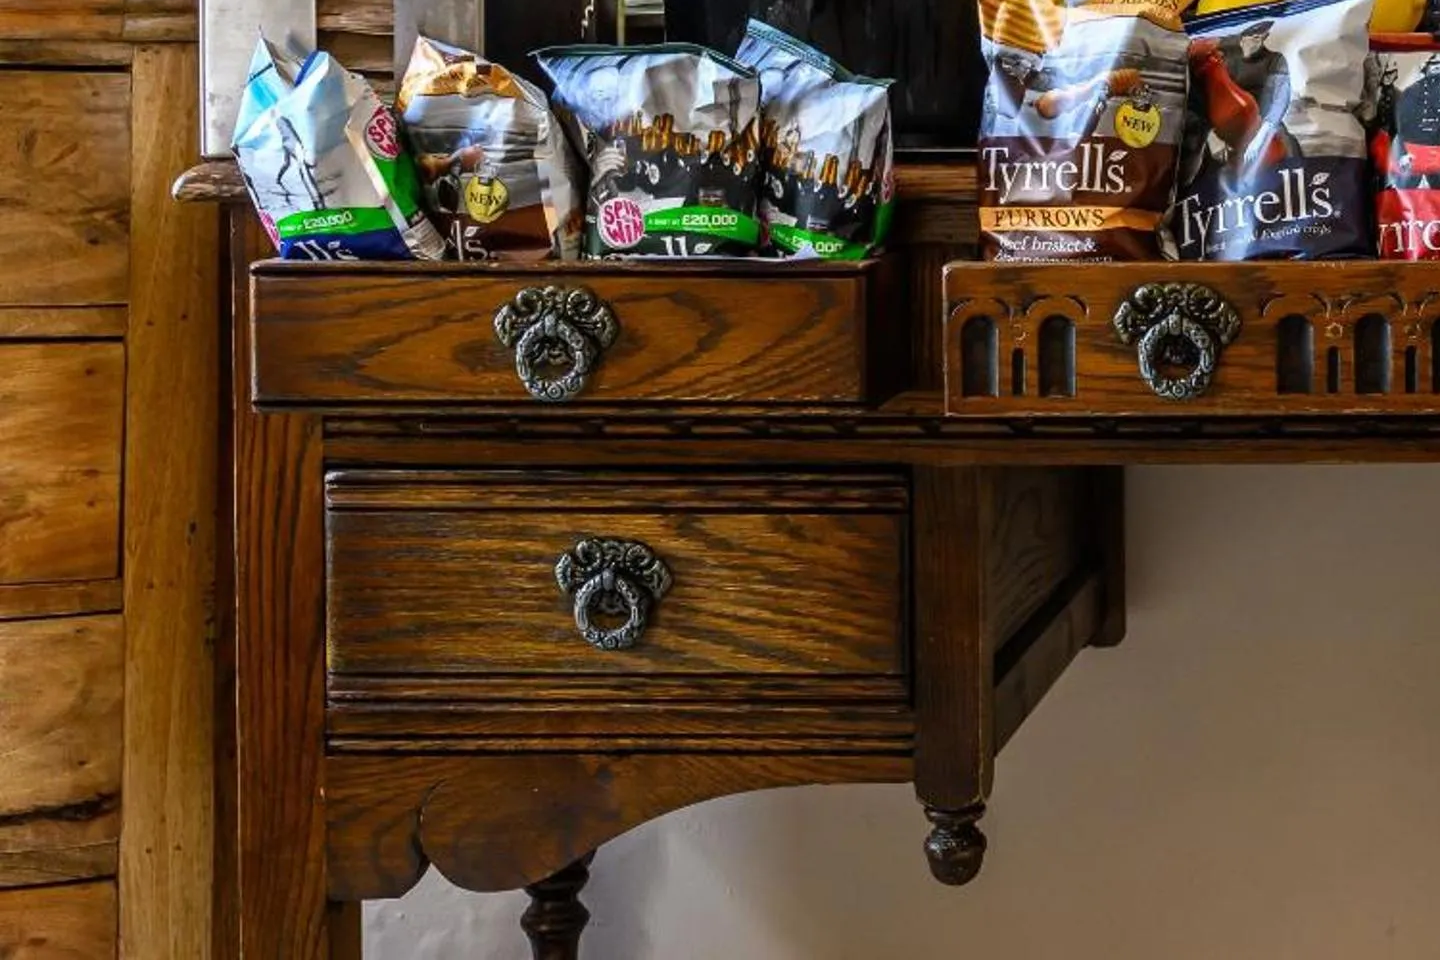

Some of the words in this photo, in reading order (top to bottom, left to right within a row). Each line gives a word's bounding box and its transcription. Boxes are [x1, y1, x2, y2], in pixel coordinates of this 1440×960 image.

[1122, 116, 1153, 133] NEW
[470, 192, 501, 205] NEW
[604, 200, 643, 225] SPIN
[682, 214, 738, 227] £20,000
[993, 208, 1105, 227] FURROWS
[606, 219, 644, 244] WIN
